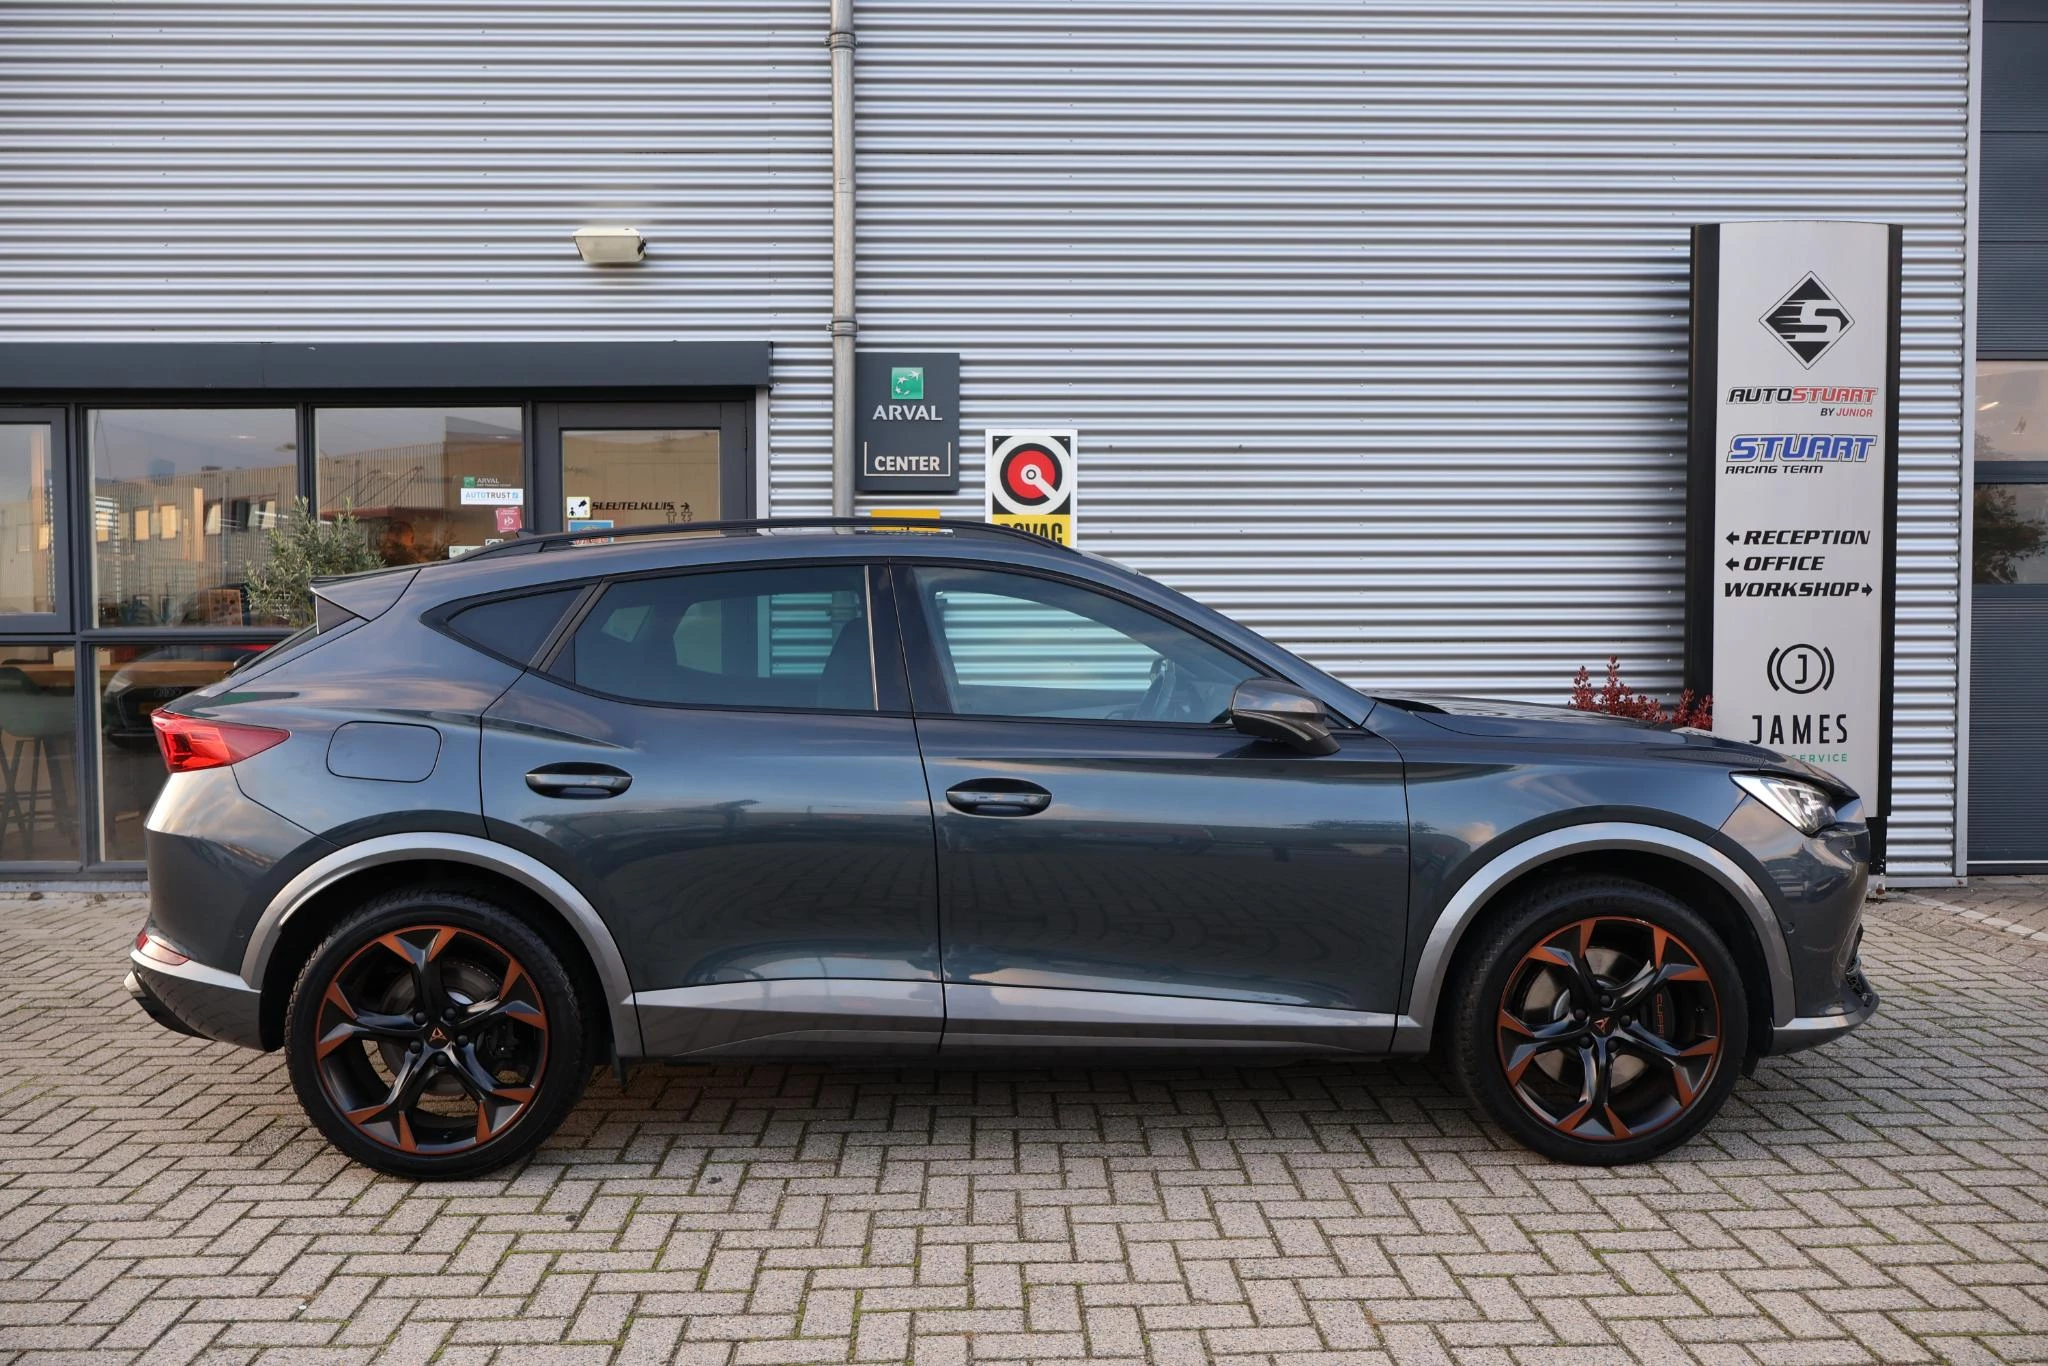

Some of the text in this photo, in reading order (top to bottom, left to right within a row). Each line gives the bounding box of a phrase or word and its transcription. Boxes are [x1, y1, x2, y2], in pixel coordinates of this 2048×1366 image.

[872, 405, 943, 421] ARVAL
[1820, 408, 1873, 417] BY JUNIOR
[1728, 434, 1877, 462] STUART
[874, 456, 941, 471] CENTER
[1725, 465, 1824, 475] RACING TEAM
[1743, 530, 1871, 545] RECEPTION
[1743, 556, 1826, 571] OFFICE
[1724, 582, 1860, 597] WORKSHOP
[1750, 714, 1848, 745] JAMES
